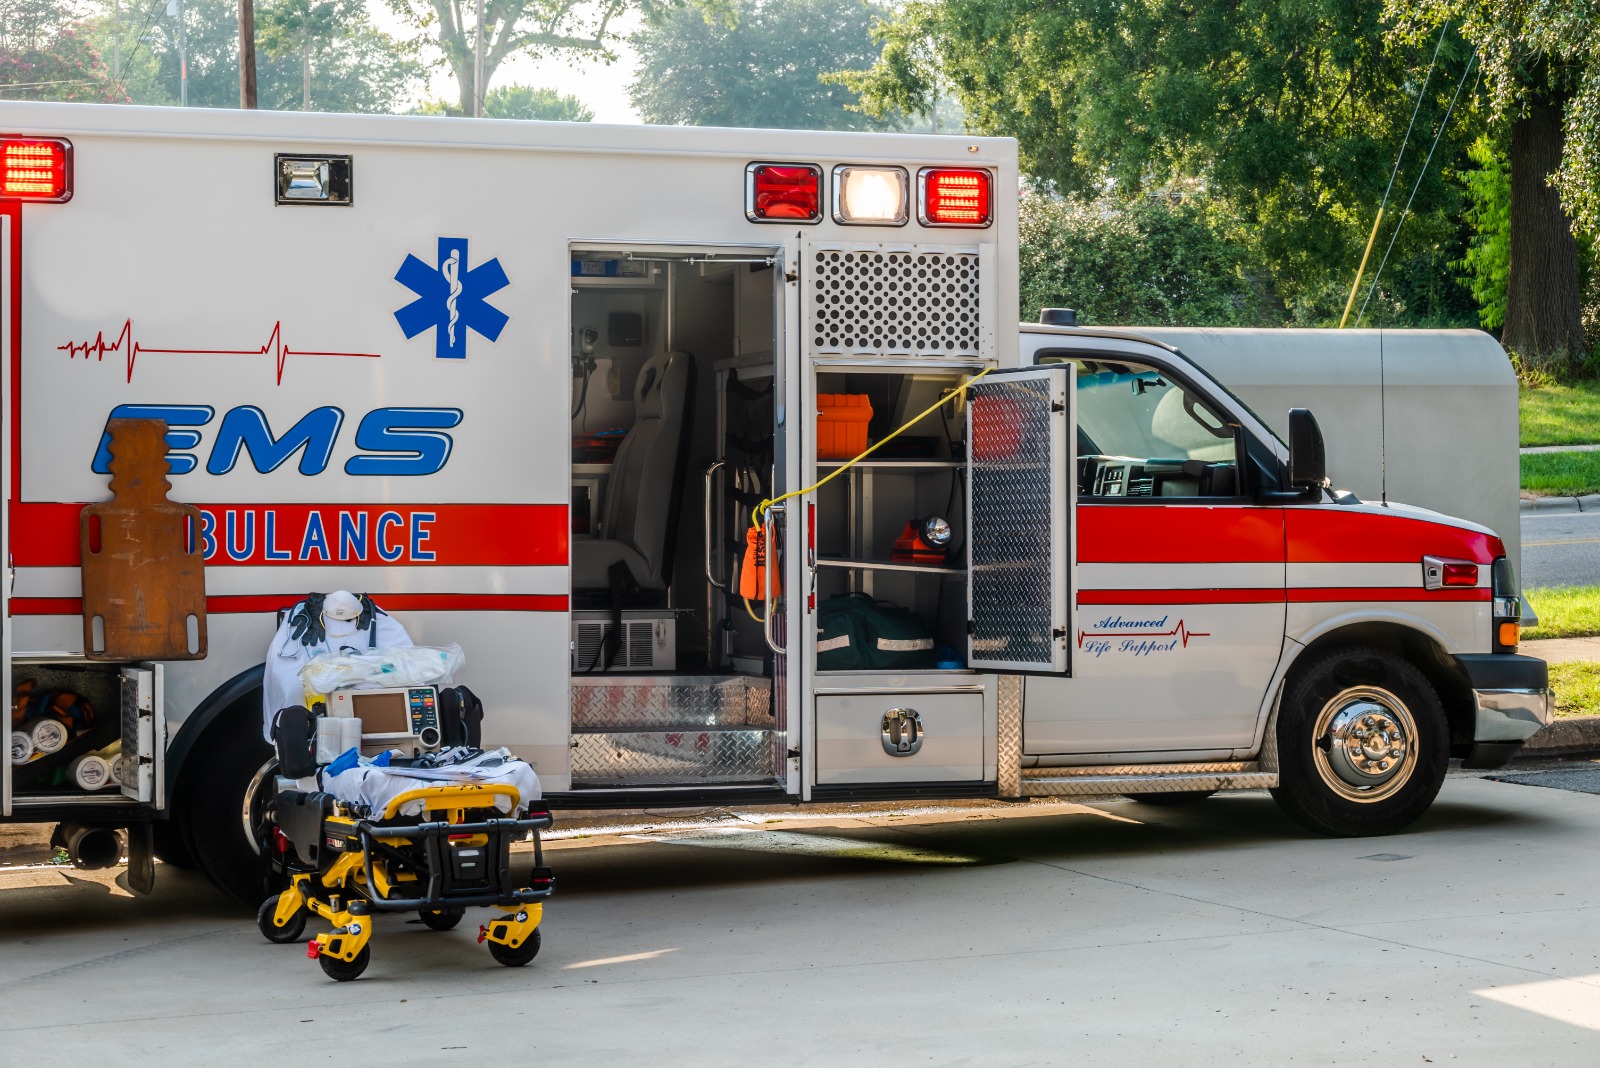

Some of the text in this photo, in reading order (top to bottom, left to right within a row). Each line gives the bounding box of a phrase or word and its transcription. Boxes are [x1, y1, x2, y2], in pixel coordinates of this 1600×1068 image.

[91, 404, 464, 476] EMS
[188, 510, 436, 562] BULANCE
[1093, 615, 1168, 628] Advanced
[1083, 639, 1177, 658] Life Support
